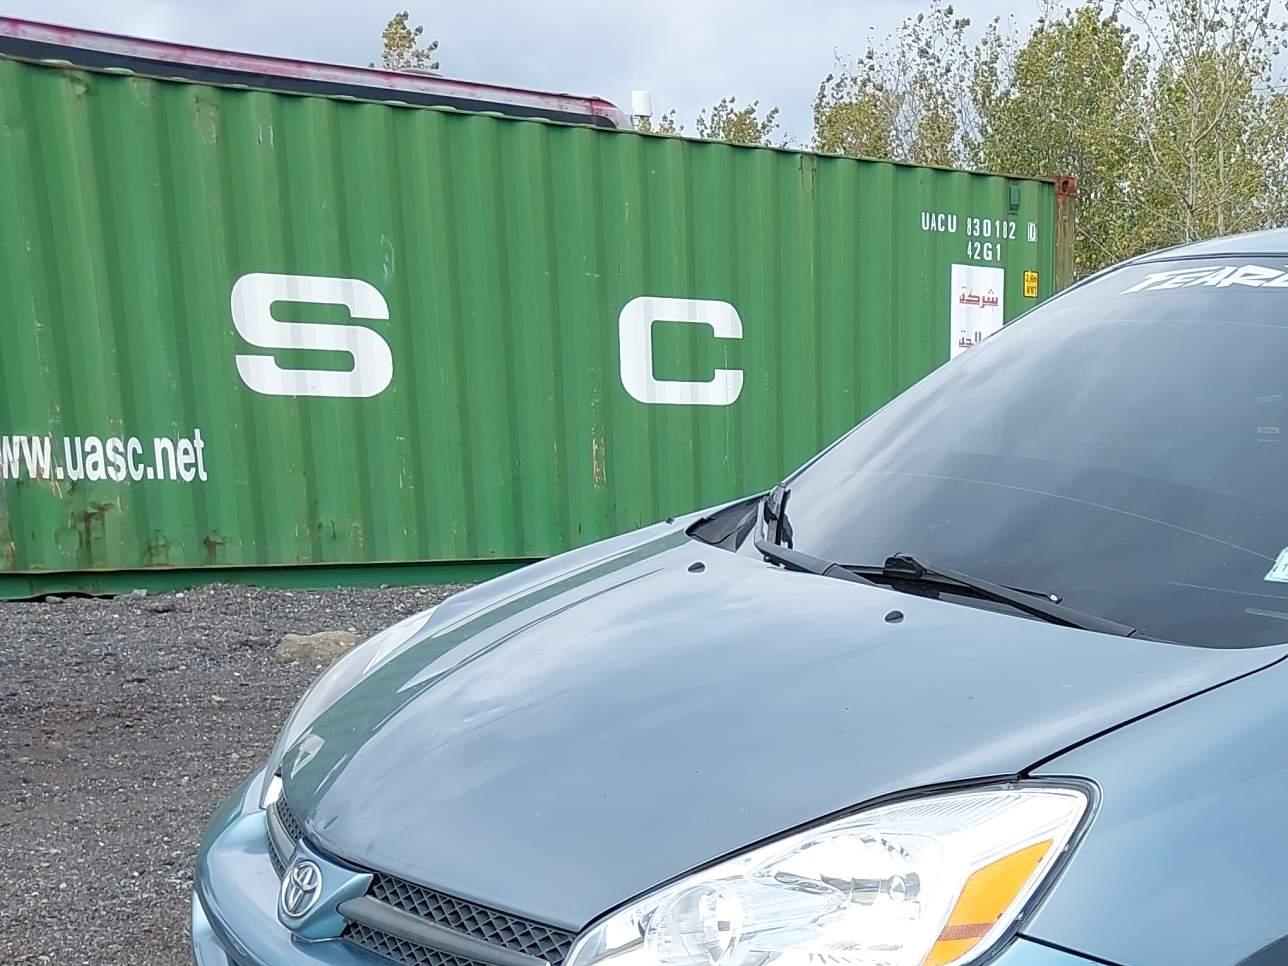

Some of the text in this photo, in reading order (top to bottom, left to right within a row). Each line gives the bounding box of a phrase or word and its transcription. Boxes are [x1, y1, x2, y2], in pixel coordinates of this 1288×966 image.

[921, 211, 957, 233] UACU
[966, 217, 1016, 239] 830182
[967, 240, 1001, 261] 42G1
[231, 272, 394, 398] S
[619, 296, 743, 406] C
